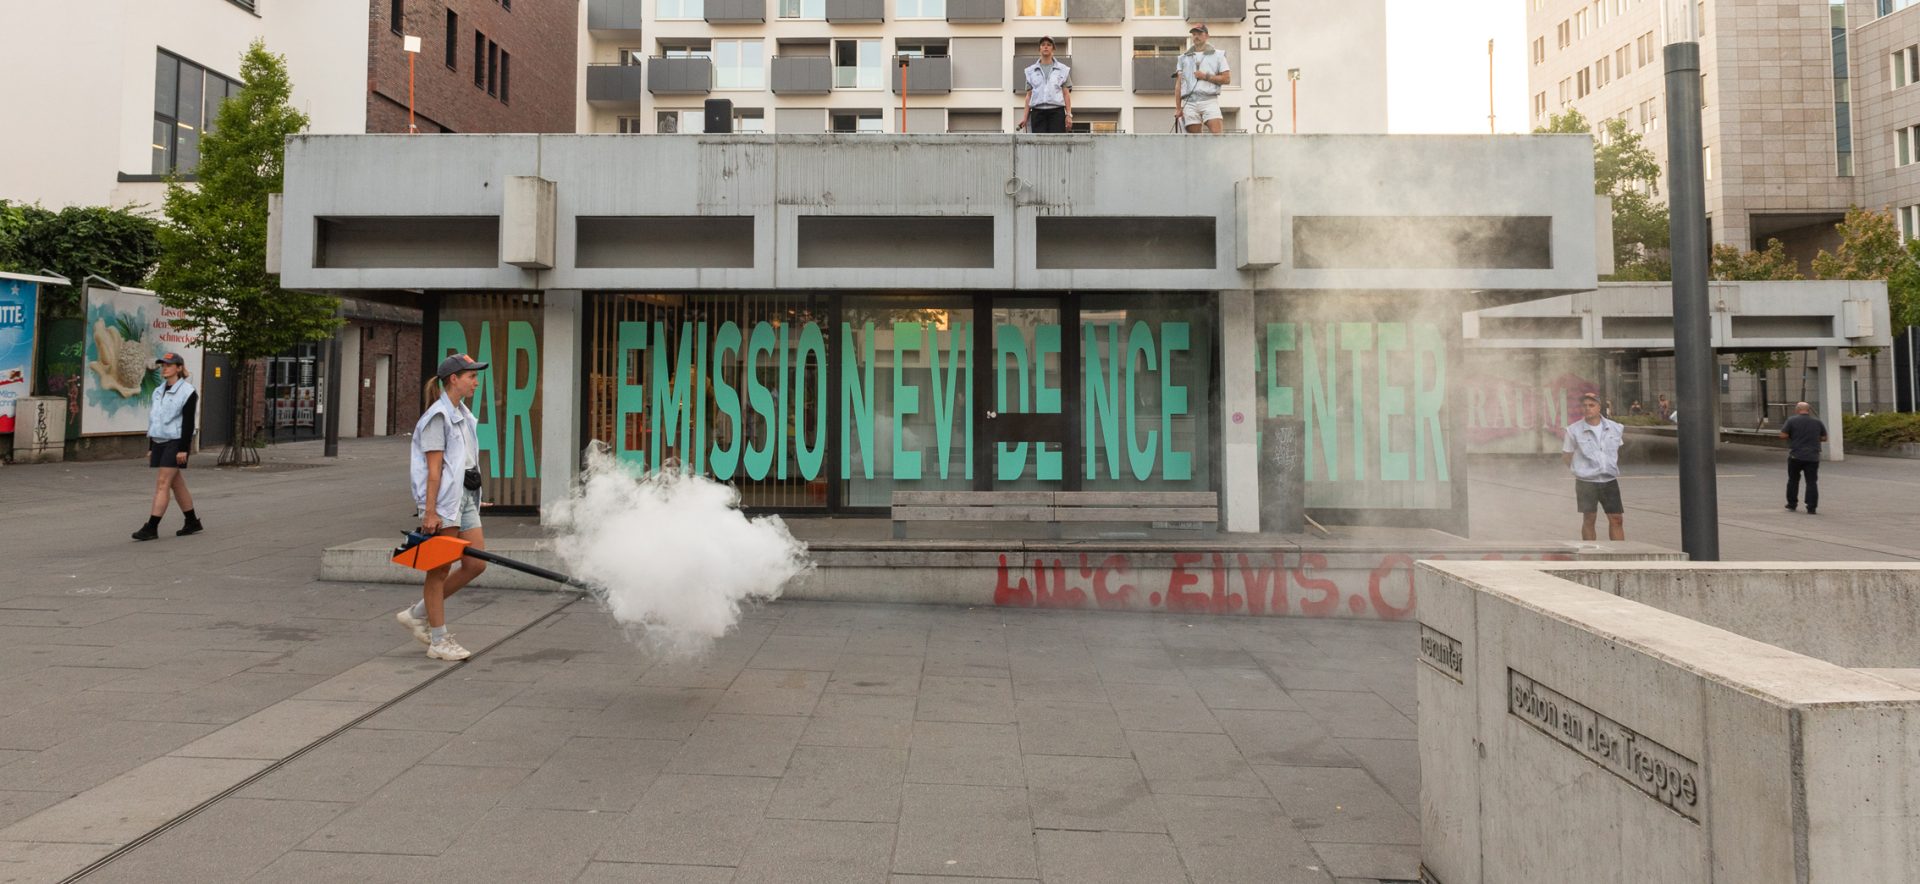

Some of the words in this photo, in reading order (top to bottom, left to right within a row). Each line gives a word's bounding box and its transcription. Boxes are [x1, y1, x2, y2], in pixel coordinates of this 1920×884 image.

[1254, 321, 1449, 481] ENTER
[1466, 385, 1569, 430] RAUM
[1513, 679, 1559, 729] schon
[1562, 708, 1583, 744] an
[1587, 714, 1620, 763] der
[1618, 729, 1698, 808] Treppe
